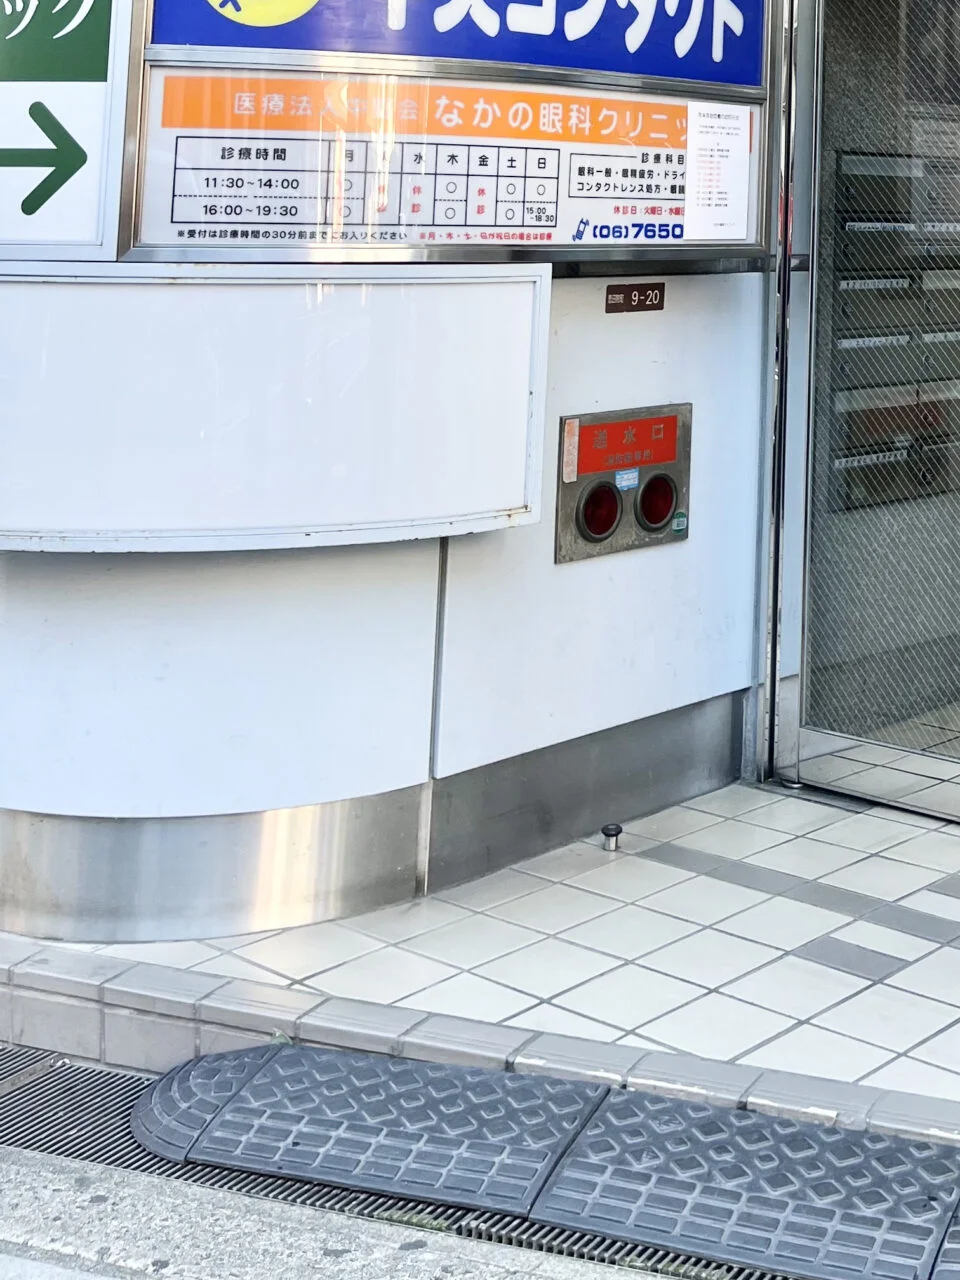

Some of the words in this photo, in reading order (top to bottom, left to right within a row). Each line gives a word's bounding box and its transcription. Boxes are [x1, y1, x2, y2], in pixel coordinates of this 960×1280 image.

[221, 147, 287, 161] 診療時間
[447, 153, 459, 165] 木
[478, 154, 490, 167] 金
[507, 157, 517, 169] 土
[537, 158, 547, 169] 日
[631, 289, 659, 306] 9-20
